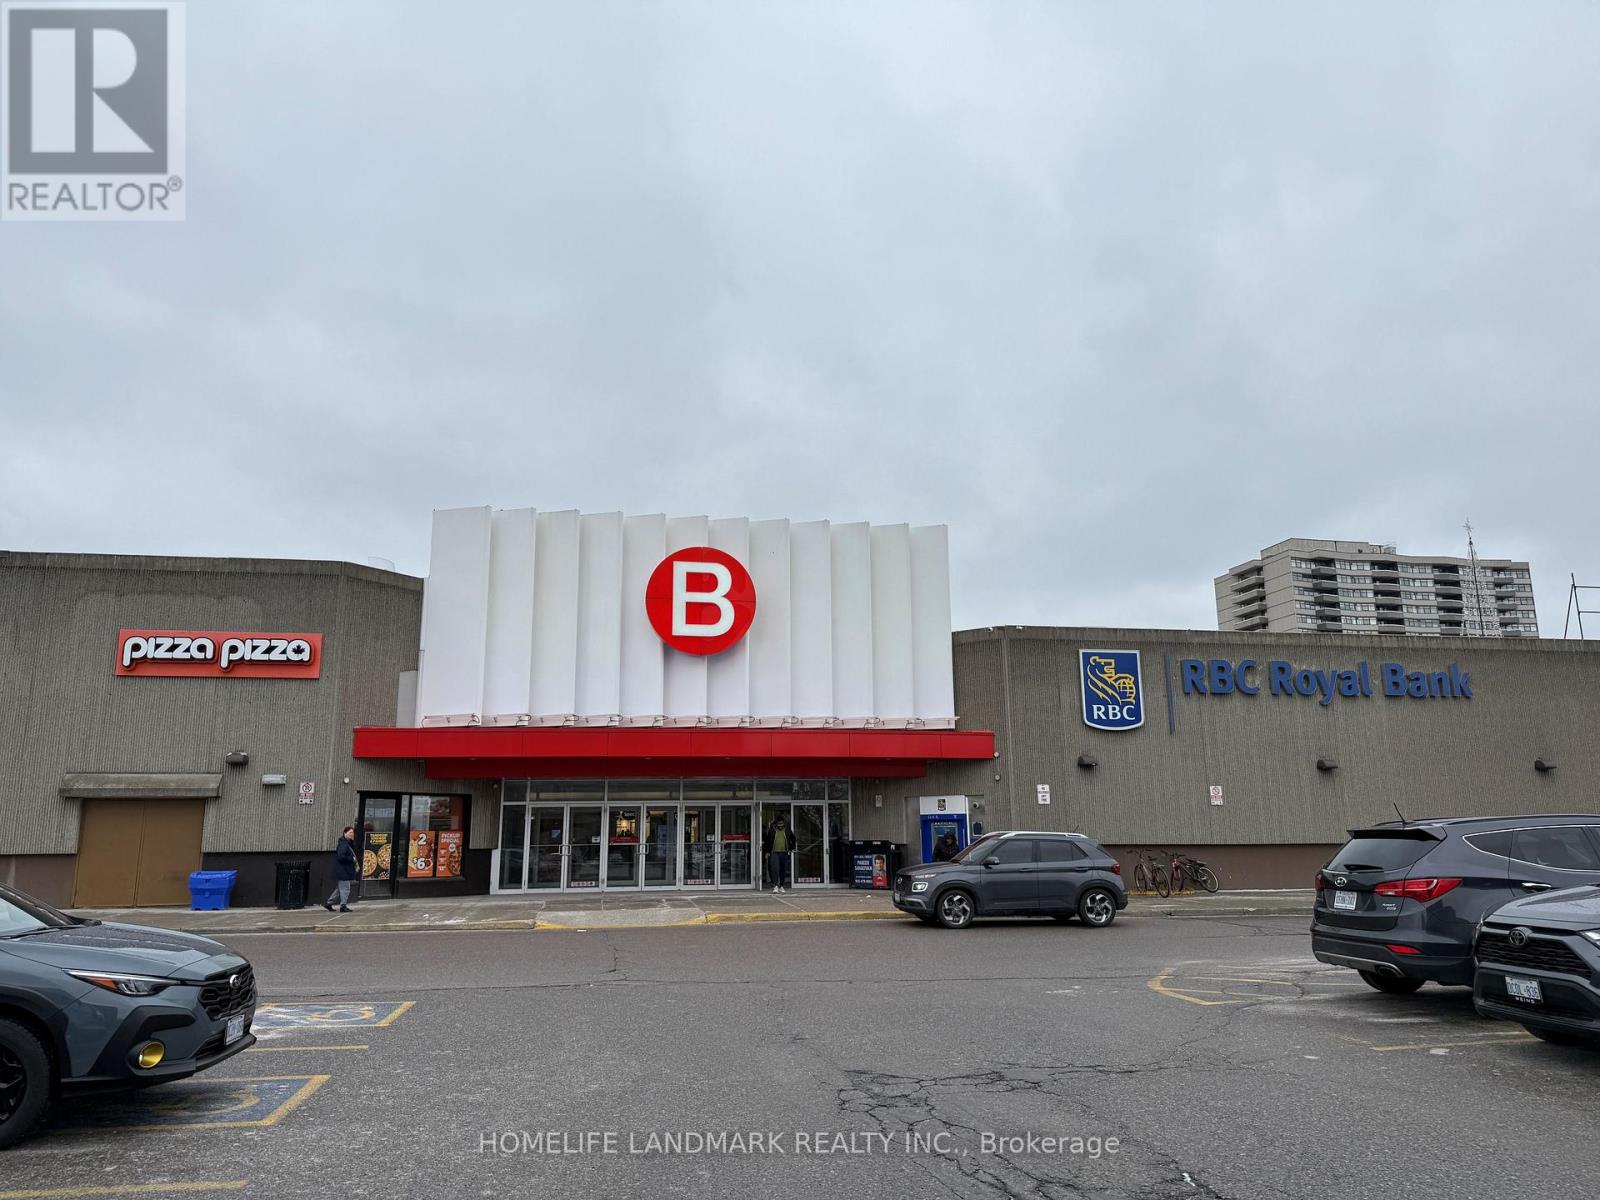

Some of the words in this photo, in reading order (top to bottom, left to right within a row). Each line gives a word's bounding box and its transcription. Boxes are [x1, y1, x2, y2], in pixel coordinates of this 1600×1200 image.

[672, 560, 736, 637] B
[122, 636, 215, 668] pizza
[219, 638, 312, 670] pizza
[1181, 658, 1261, 696] RBC
[1269, 659, 1373, 706] Royal
[1380, 661, 1474, 699] Bank
[1092, 704, 1136, 720] RBC
[418, 832, 427, 845] 2
